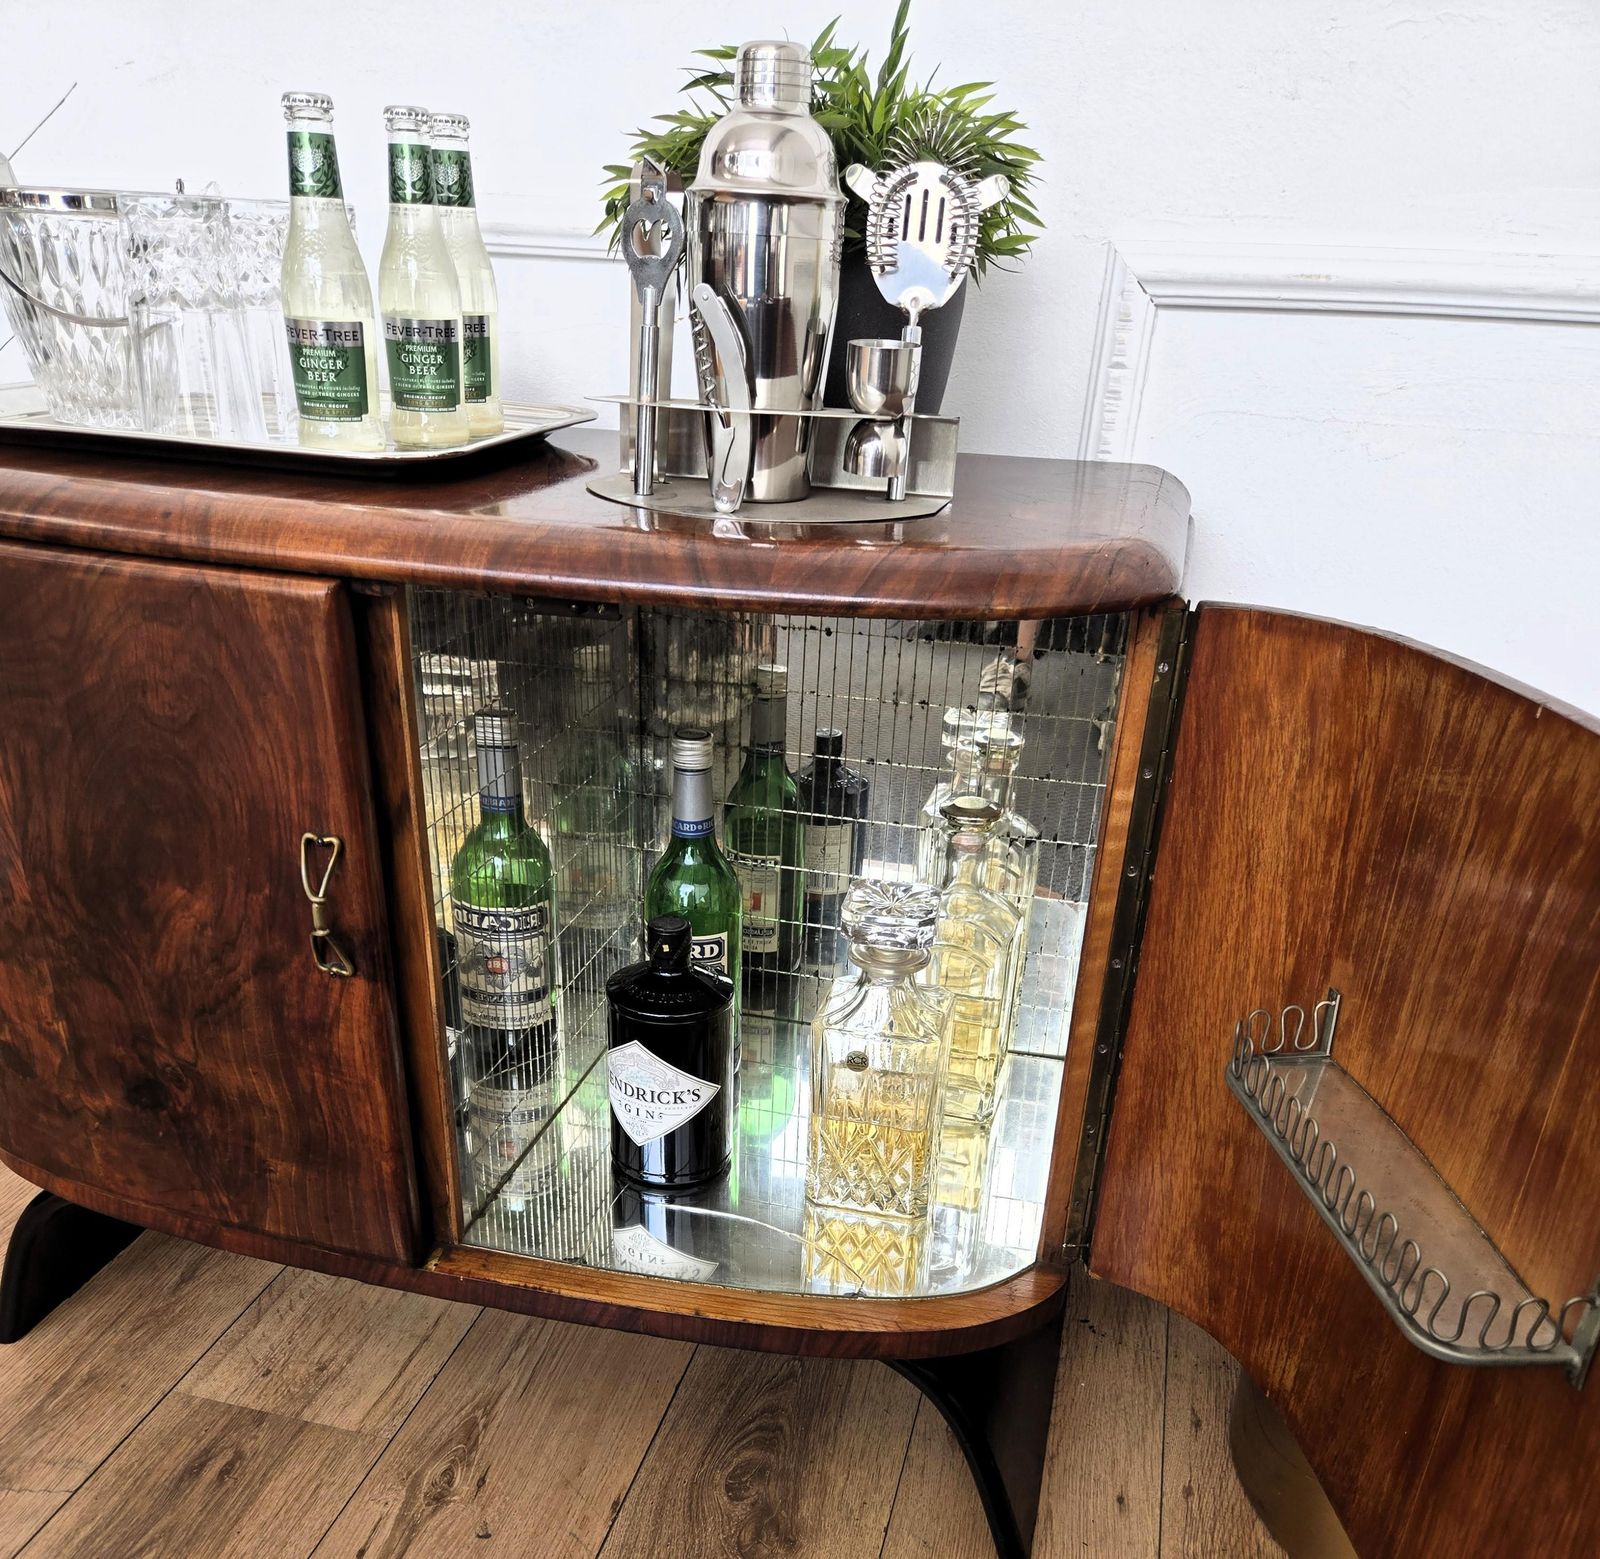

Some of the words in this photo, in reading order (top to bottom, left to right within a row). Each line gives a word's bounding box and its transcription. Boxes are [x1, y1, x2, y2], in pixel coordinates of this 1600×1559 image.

[286, 325, 360, 341] FEVER-TREE
[386, 322, 456, 338] FEVER-TREE
[302, 348, 336, 357] PREMIUM
[406, 344, 438, 352] PREMIUM
[300, 358, 344, 370] GINGER
[401, 354, 444, 364] GINGER
[307, 371, 337, 382] BEER
[409, 366, 438, 376] BEER
[672, 820, 697, 832] CARD
[847, 1056, 867, 1066] RCR
[609, 1070, 701, 1104] ENDRICK'S
[624, 1103, 655, 1120] GIN
